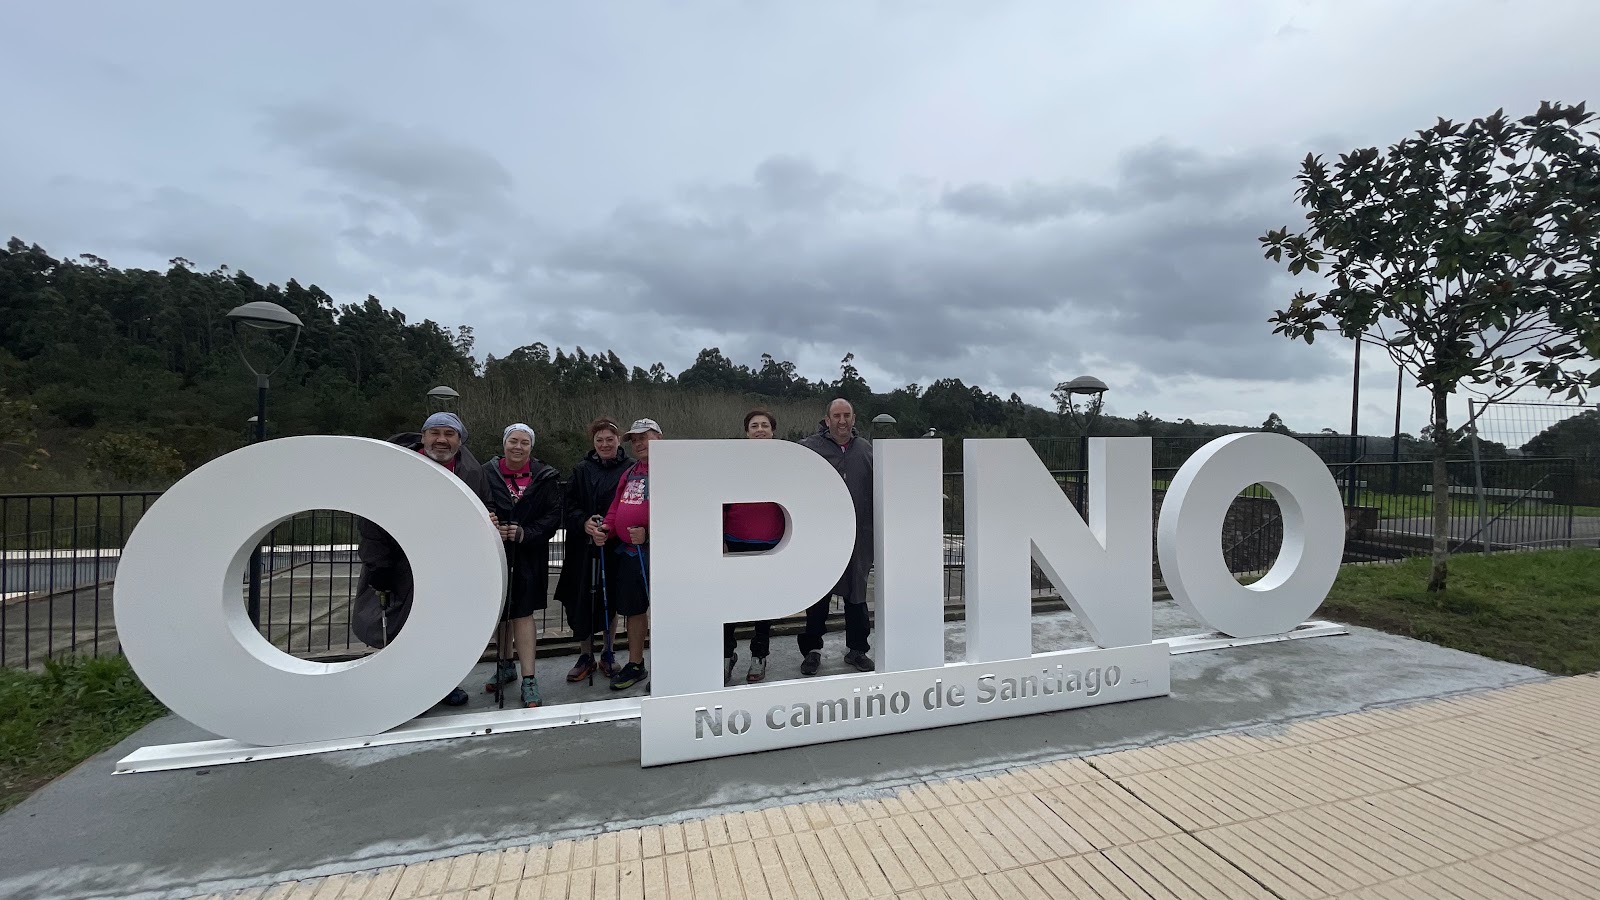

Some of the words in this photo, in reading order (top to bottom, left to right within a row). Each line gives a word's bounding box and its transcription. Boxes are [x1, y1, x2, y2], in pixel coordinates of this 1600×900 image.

[113, 435, 508, 747] O
[649, 432, 1346, 698] PINO
[694, 704, 752, 741] No
[765, 683, 911, 731] camiño
[922, 678, 966, 712] de
[976, 664, 1122, 704] Santiago
